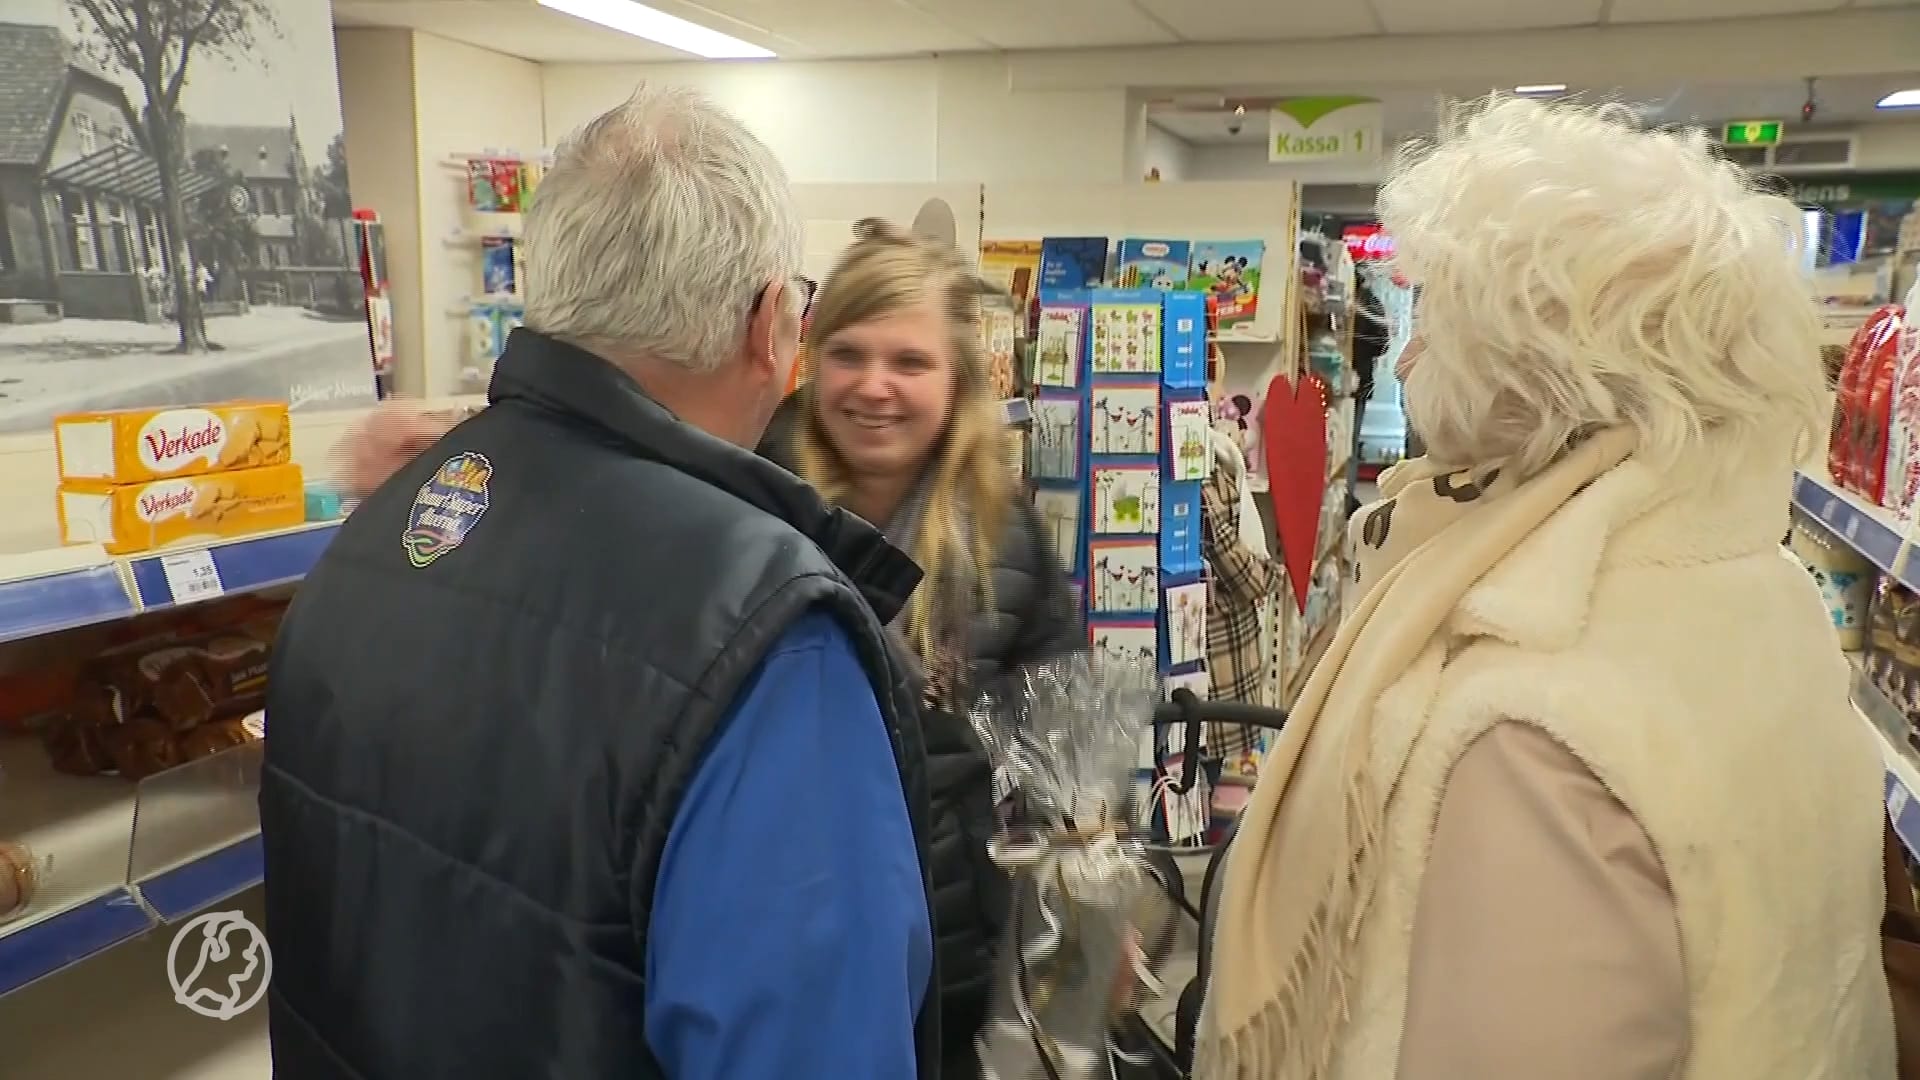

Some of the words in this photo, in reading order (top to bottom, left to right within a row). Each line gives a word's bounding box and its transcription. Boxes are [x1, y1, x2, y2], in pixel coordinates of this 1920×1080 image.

[1276, 131, 1339, 155] Kassa
[1353, 128, 1363, 153] 1
[143, 417, 222, 463] Verkade
[140, 485, 195, 516] Verkade
